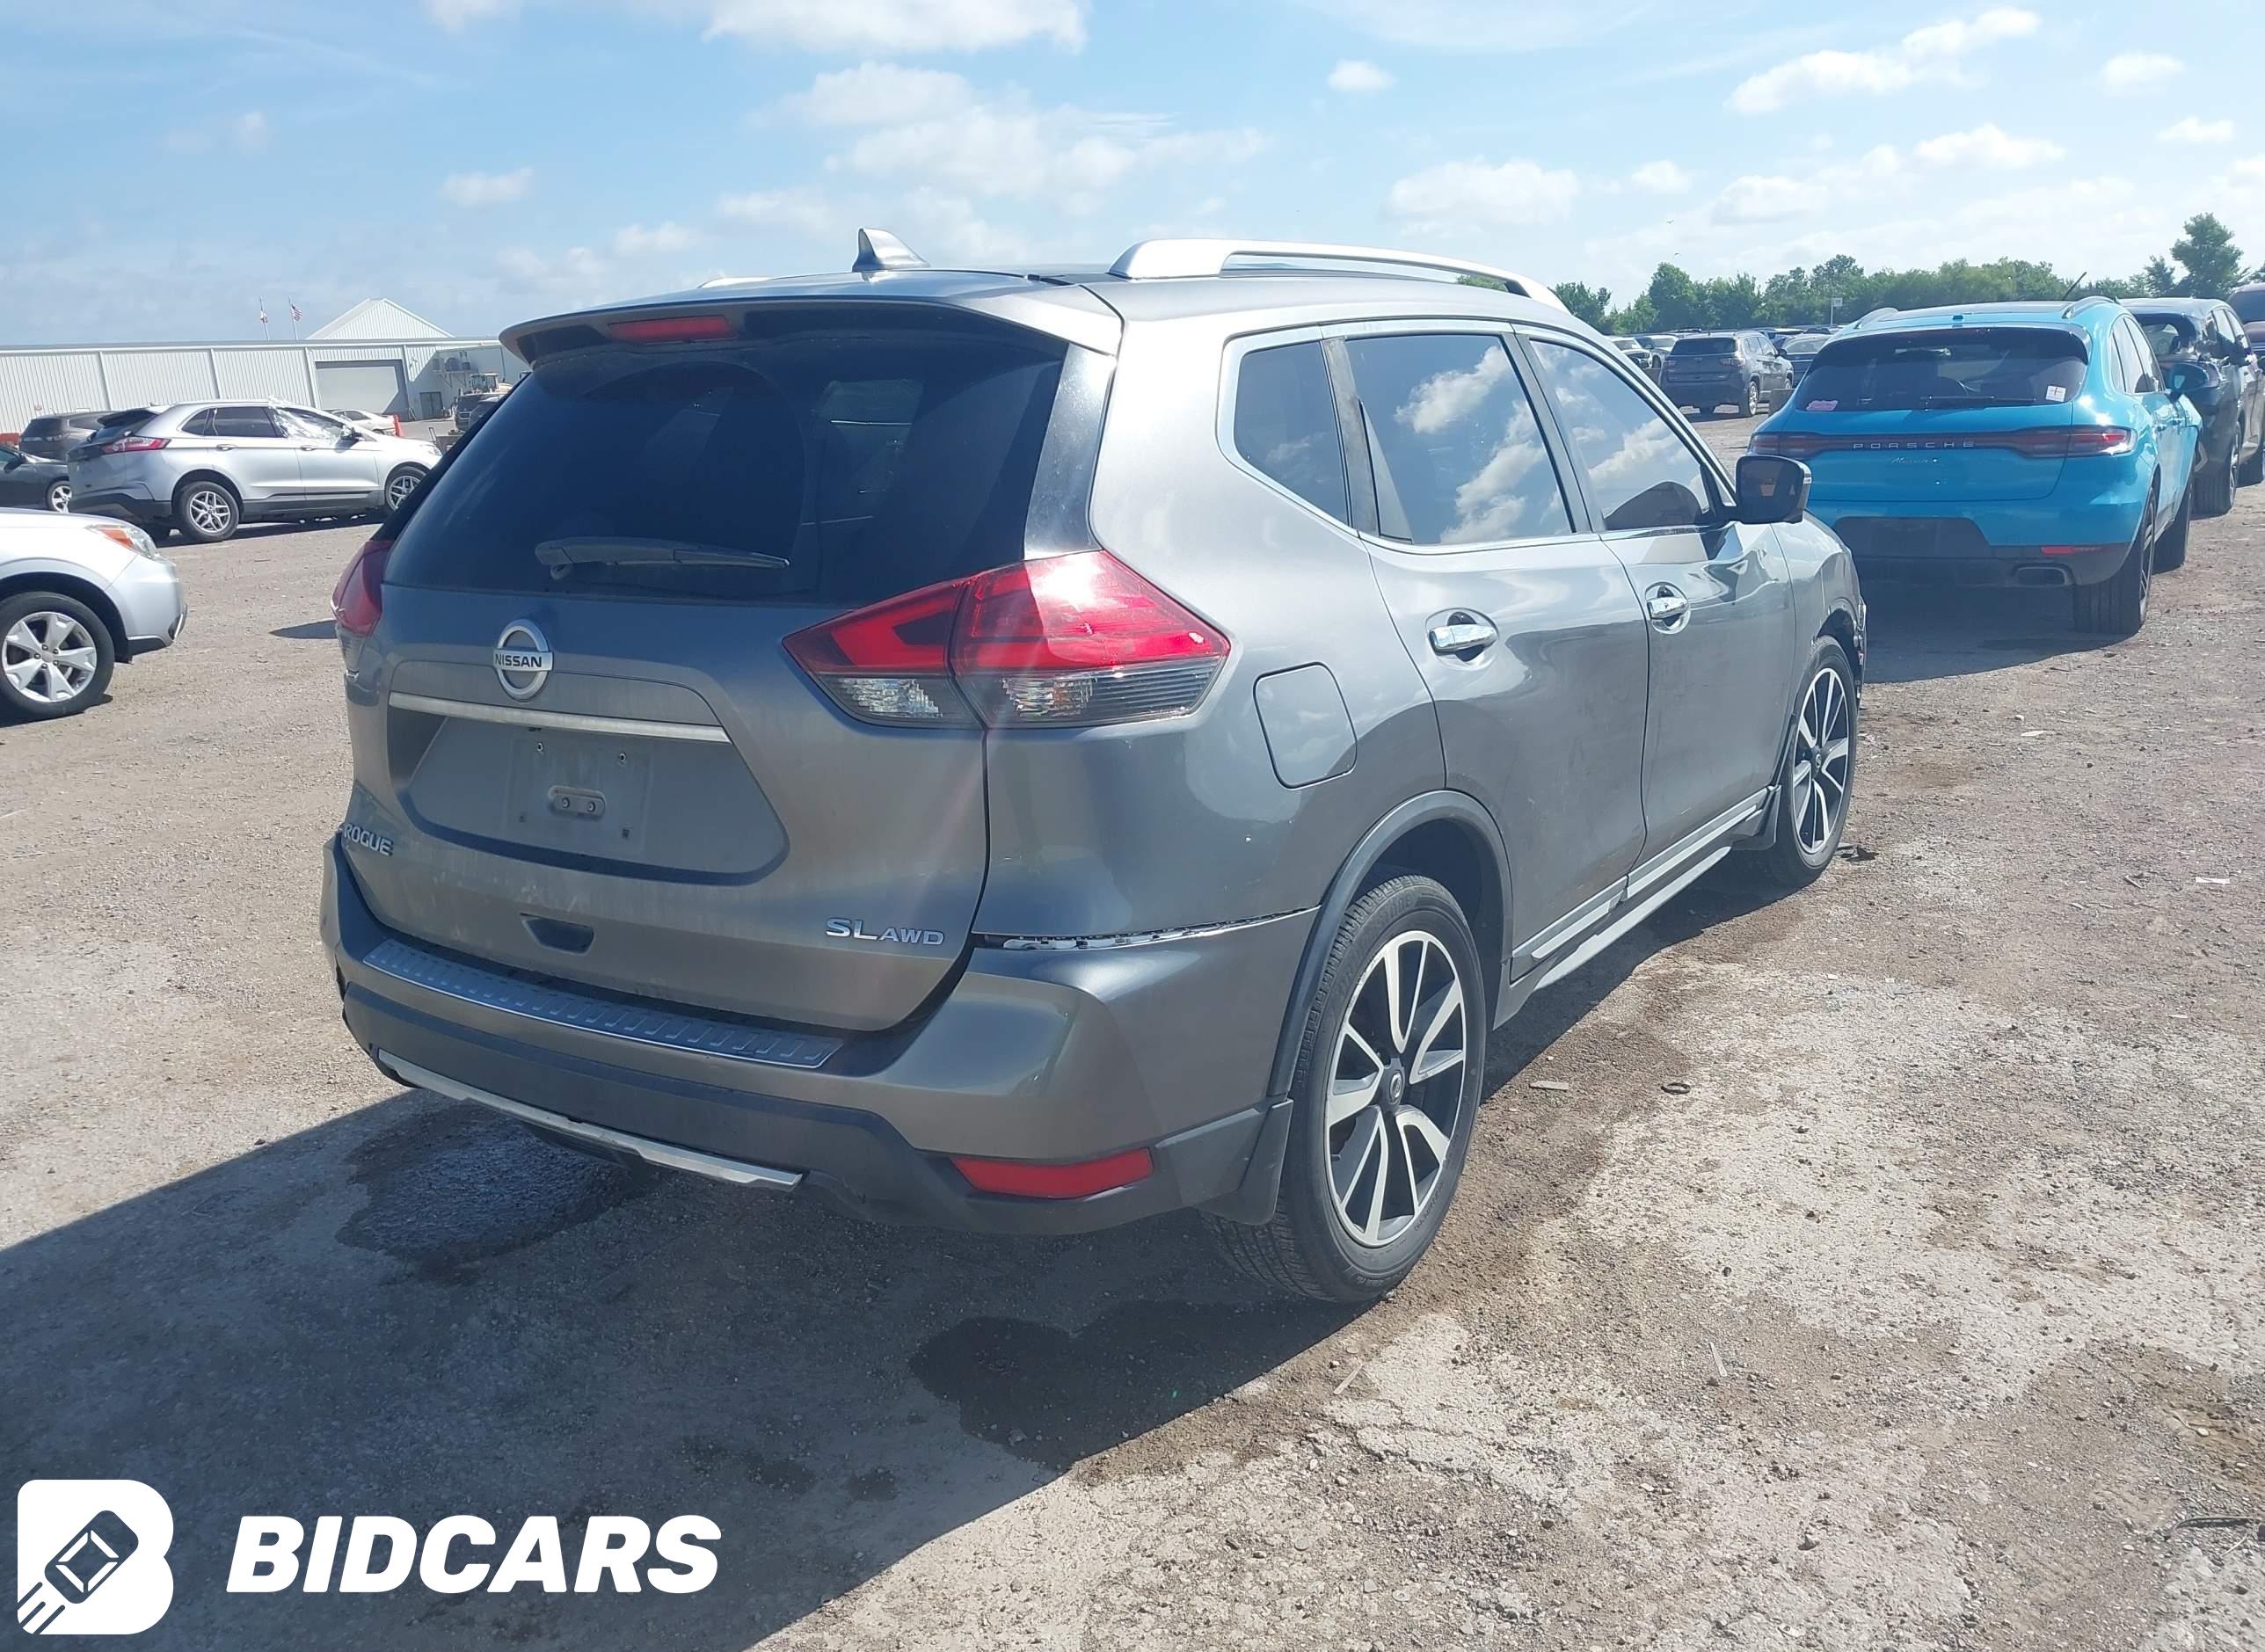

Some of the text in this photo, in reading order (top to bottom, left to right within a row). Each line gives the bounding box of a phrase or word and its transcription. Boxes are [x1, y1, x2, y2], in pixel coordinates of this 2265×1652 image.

[495, 653, 543, 668] NISSAN
[344, 823, 393, 856] ROGUE
[826, 918, 944, 945] SL AWD
